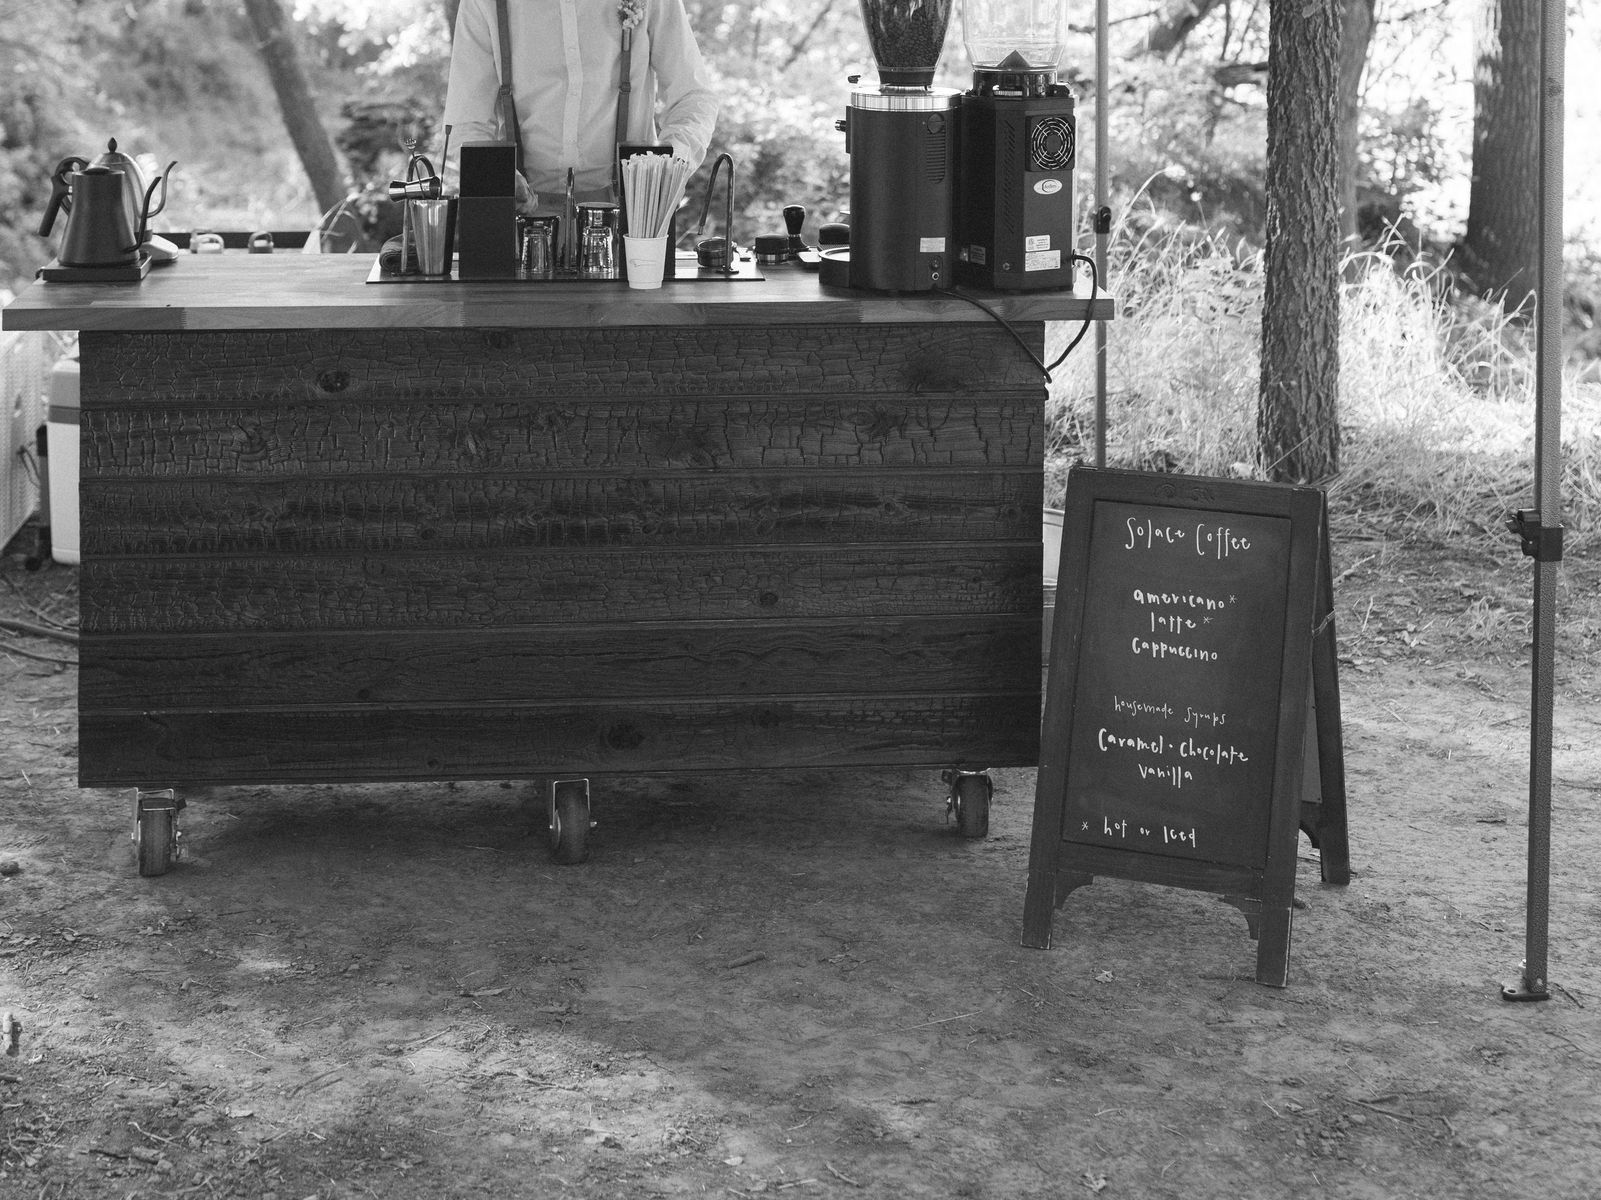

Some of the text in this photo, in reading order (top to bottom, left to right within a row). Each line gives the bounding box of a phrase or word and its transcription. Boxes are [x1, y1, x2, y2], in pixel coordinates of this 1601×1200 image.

[1125, 517, 1252, 560] Solace Coffee
[1151, 611, 1198, 635] latte
[1114, 695, 1174, 720] housemade
[1098, 727, 1165, 755] Caramel
[1104, 815, 1129, 839] hot
[1139, 826, 1151, 837] or
